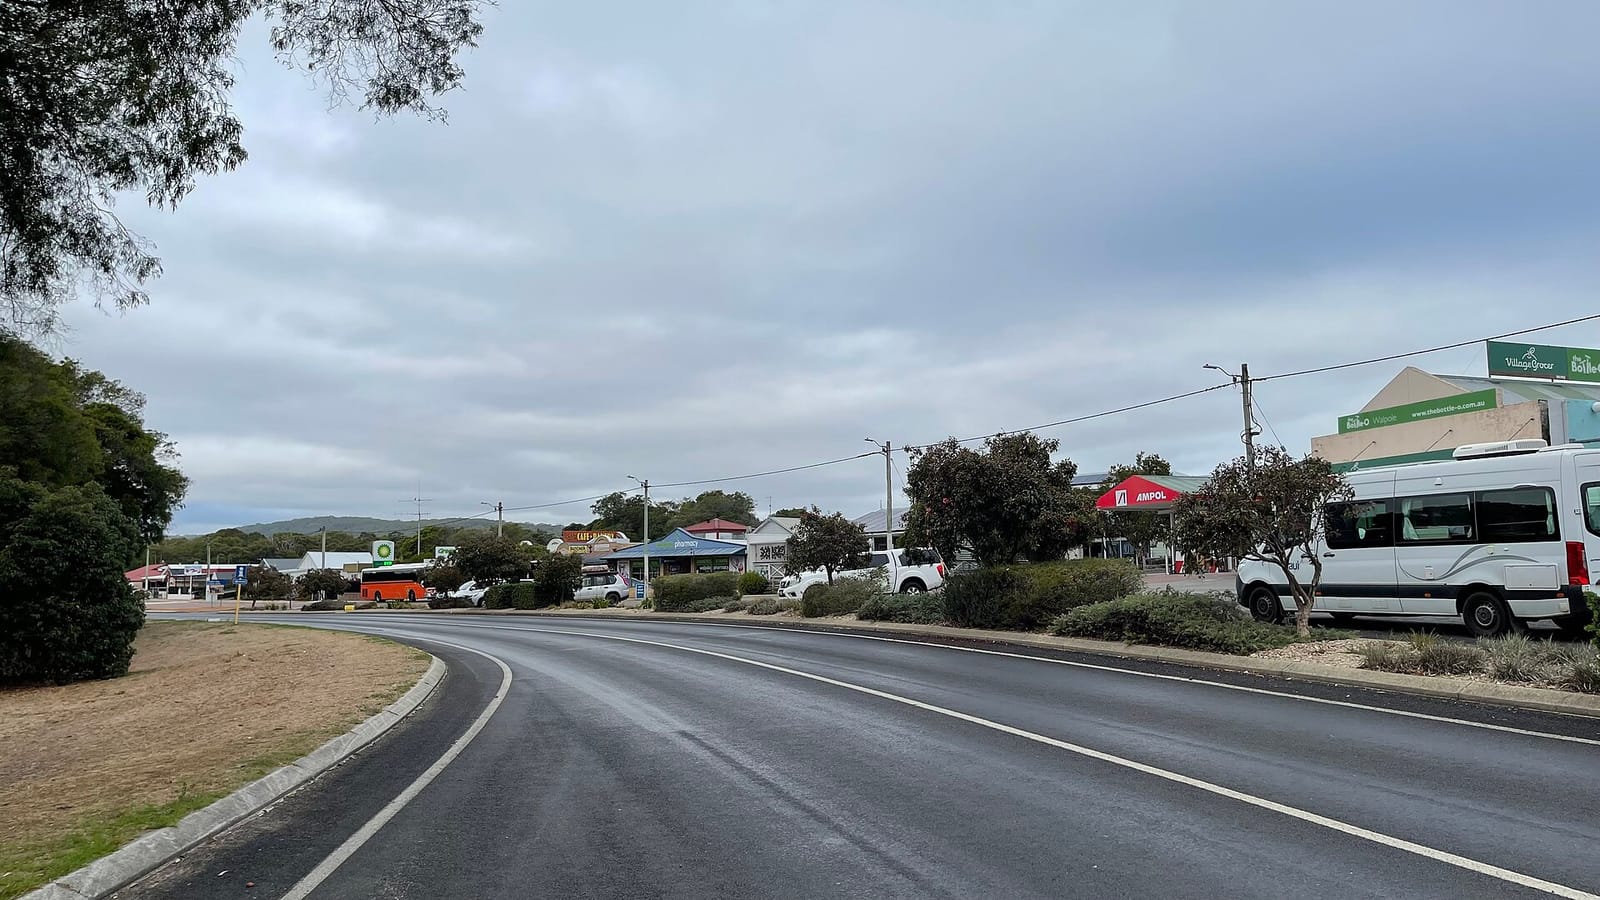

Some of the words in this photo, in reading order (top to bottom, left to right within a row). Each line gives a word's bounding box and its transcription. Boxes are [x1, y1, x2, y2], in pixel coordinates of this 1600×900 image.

[1411, 401, 1486, 417] www.thebottle-o.com.au
[1372, 414, 1398, 425] Walpole
[1136, 490, 1167, 502] AMPOL
[576, 532, 591, 541] CAFE
[674, 540, 698, 549] pharmacy
